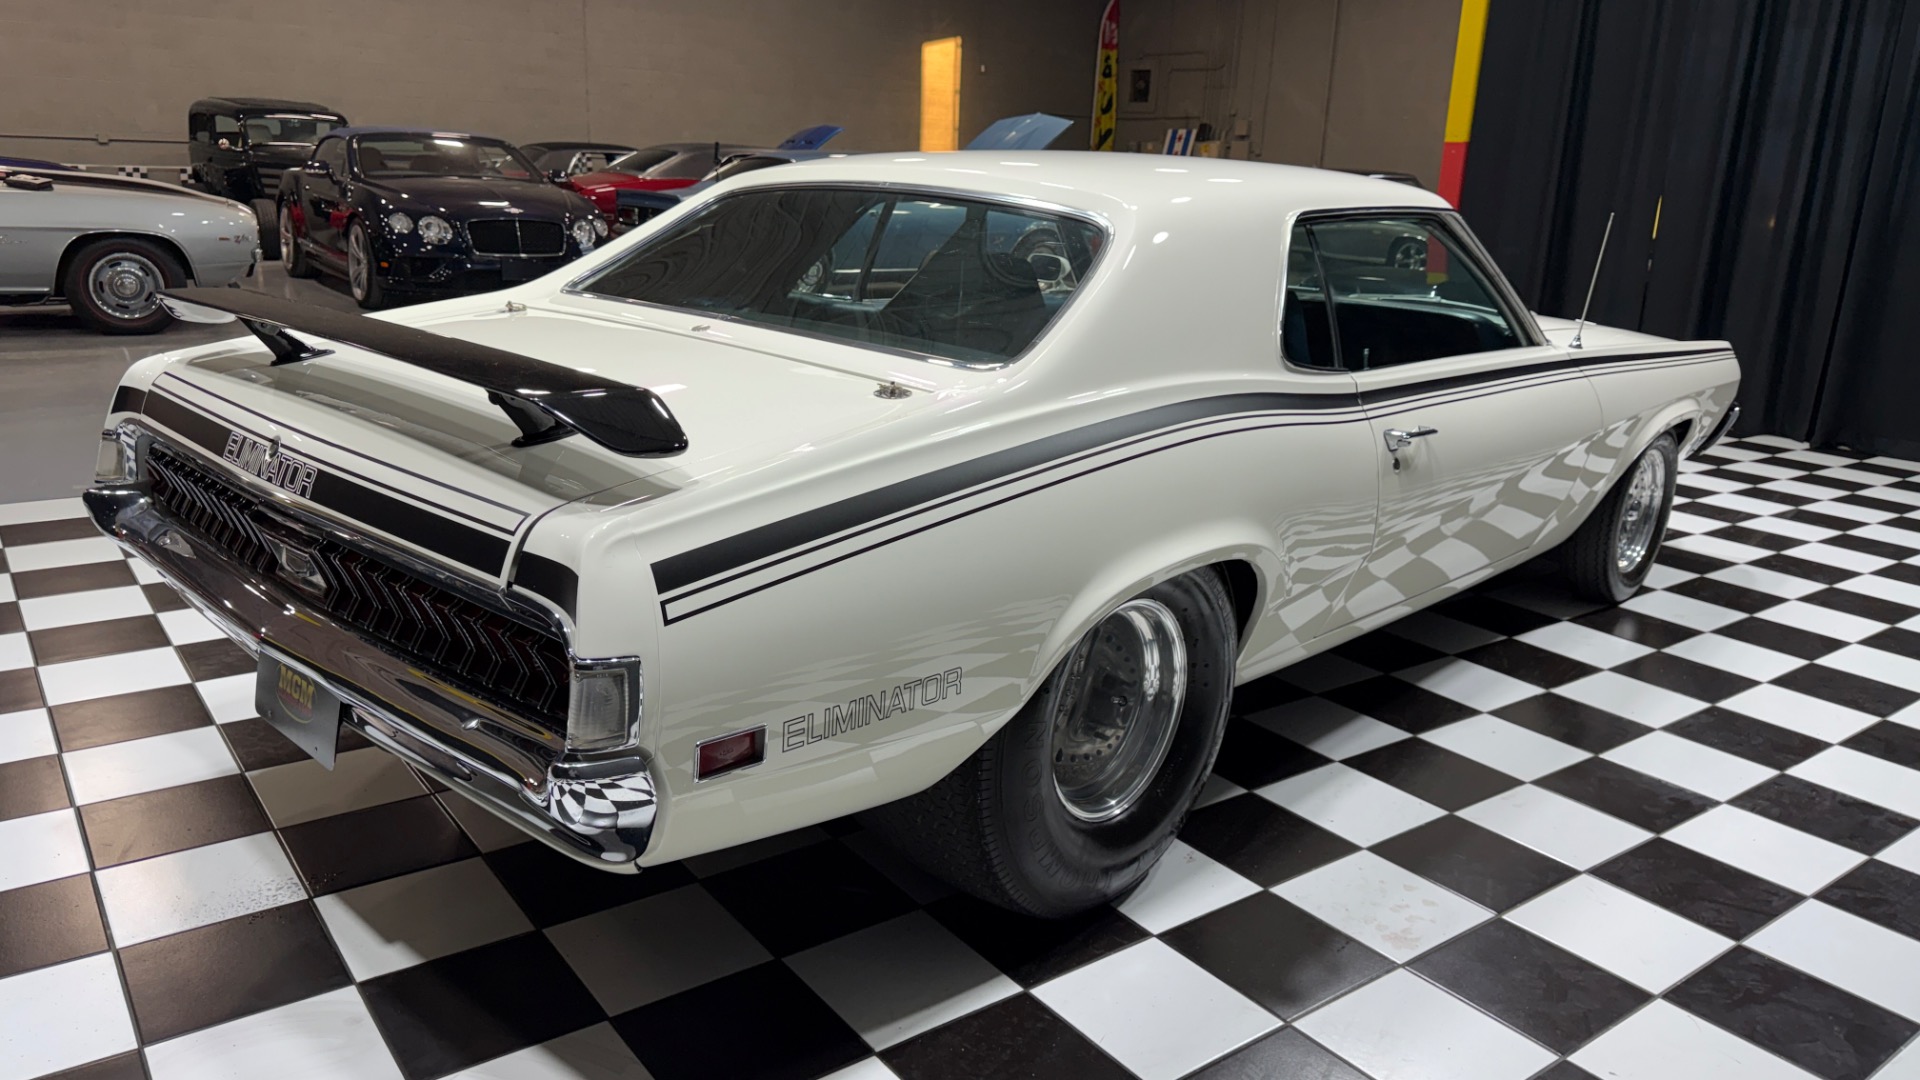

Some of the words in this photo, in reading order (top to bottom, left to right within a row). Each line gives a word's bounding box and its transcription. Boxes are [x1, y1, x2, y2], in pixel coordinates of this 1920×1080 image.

[223, 431, 318, 499] ELIMINATOR
[279, 666, 314, 709] MGM
[782, 666, 963, 753] ELIMINATOR
